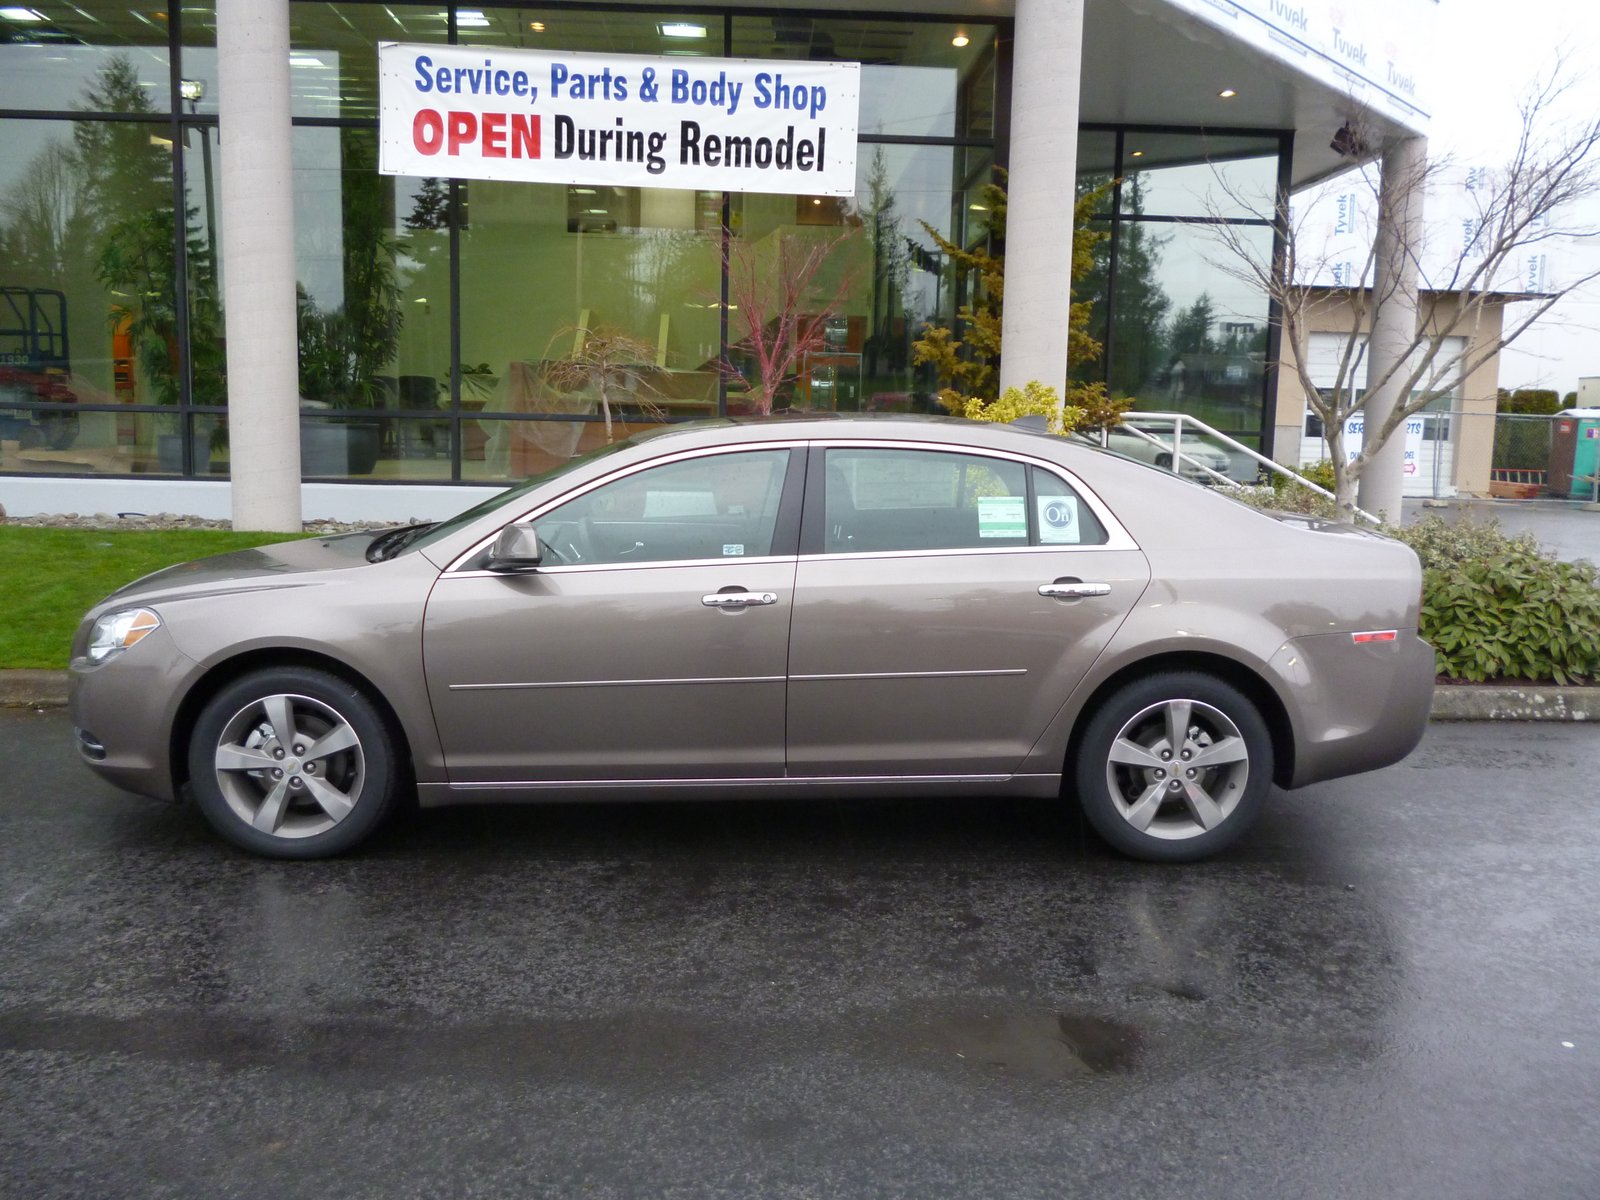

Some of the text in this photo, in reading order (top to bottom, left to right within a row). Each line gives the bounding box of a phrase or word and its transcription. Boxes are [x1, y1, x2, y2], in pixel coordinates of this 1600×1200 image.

[415, 55, 827, 119] Service, Parts & Body Shop
[412, 108, 826, 174] OPEN During Remodel
[1335, 194, 1347, 236] Tyvek
